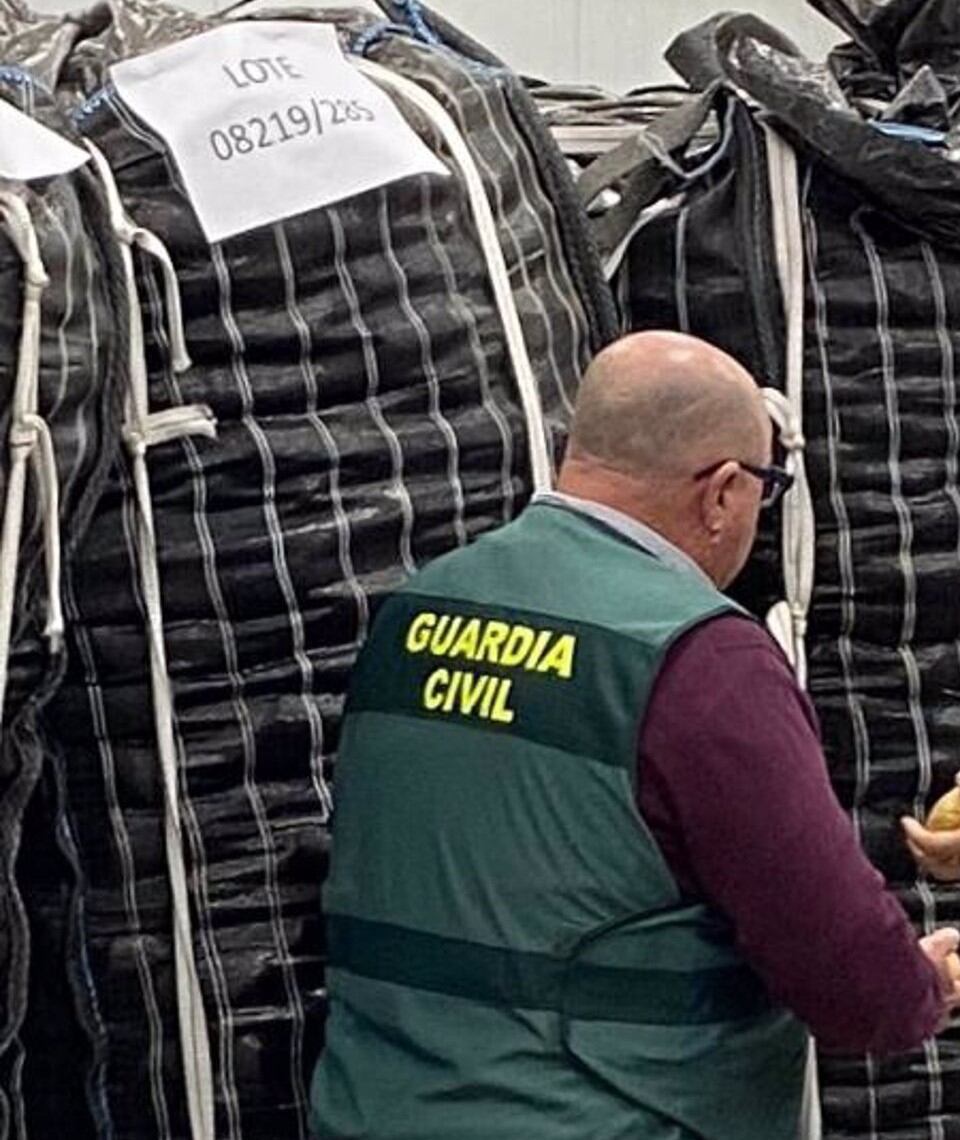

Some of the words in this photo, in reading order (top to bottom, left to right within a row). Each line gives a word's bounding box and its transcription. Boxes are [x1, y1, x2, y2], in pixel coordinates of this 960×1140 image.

[222, 56, 304, 88] LOTE
[209, 97, 376, 161] 08219/285
[405, 612, 577, 679] GUARDIA
[423, 667, 515, 723] CIVIL
